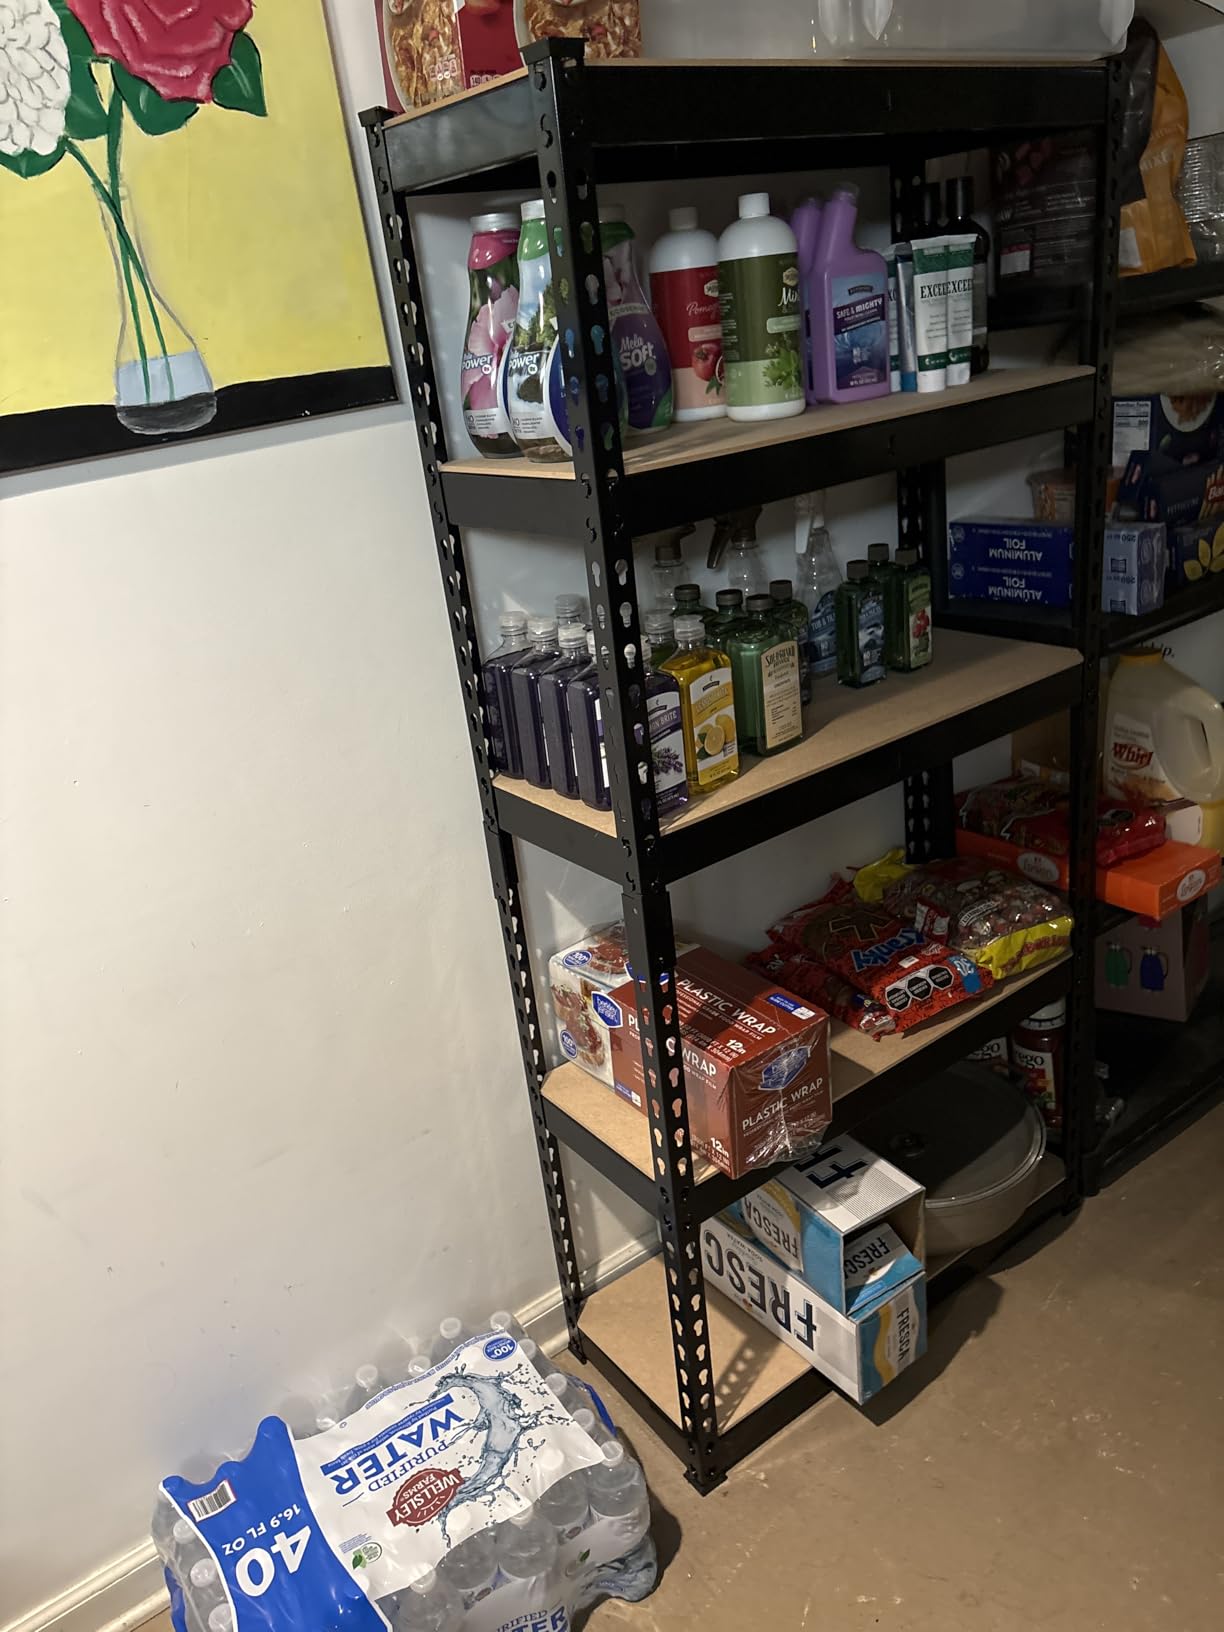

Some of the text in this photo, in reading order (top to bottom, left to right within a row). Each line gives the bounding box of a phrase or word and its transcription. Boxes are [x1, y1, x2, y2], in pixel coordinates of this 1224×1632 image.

[856, 297, 882, 312] MIGHTY
[988, 548, 1043, 561] ALUMINUM
[1003, 538, 1027, 550] FOIL
[987, 586, 1043, 600] ALUMINUM
[1002, 576, 1026, 588] FOIL
[1113, 742, 1154, 766] Whirl
[677, 978, 733, 1012] PLASTIC
[731, 1008, 776, 1035] WRAP
[742, 1077, 823, 1130] PLASTIC WRAP
[896, 1307, 911, 1362] FRESCA
[330, 1408, 465, 1495] WATER
[367, 1439, 450, 1492] PURIFIED
[394, 1473, 460, 1521] WELLSLEY
[403, 1473, 436, 1499] FARMS
[222, 1503, 302, 1556] 16.9 FL OZ
[235, 1525, 312, 1598] 40
